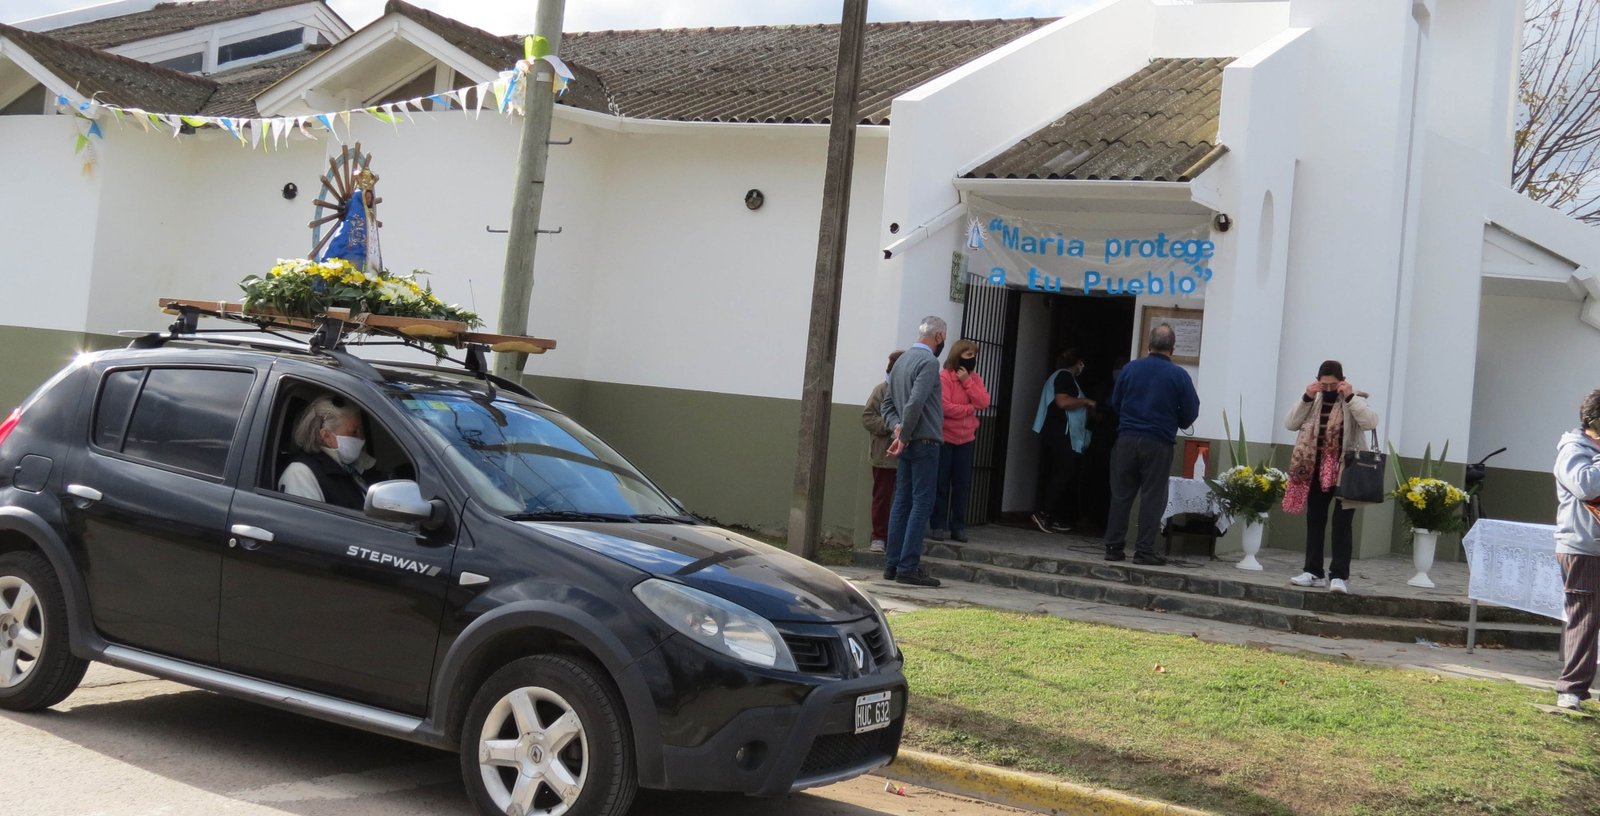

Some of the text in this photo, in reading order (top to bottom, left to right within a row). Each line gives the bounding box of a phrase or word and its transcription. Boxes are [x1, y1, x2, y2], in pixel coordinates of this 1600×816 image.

[1104, 232, 1215, 265] protege
[988, 266, 1006, 285] a
[1027, 267, 1061, 293] tu
[346, 545, 430, 574] STEPWAY
[858, 701, 889, 727] HUC 632
